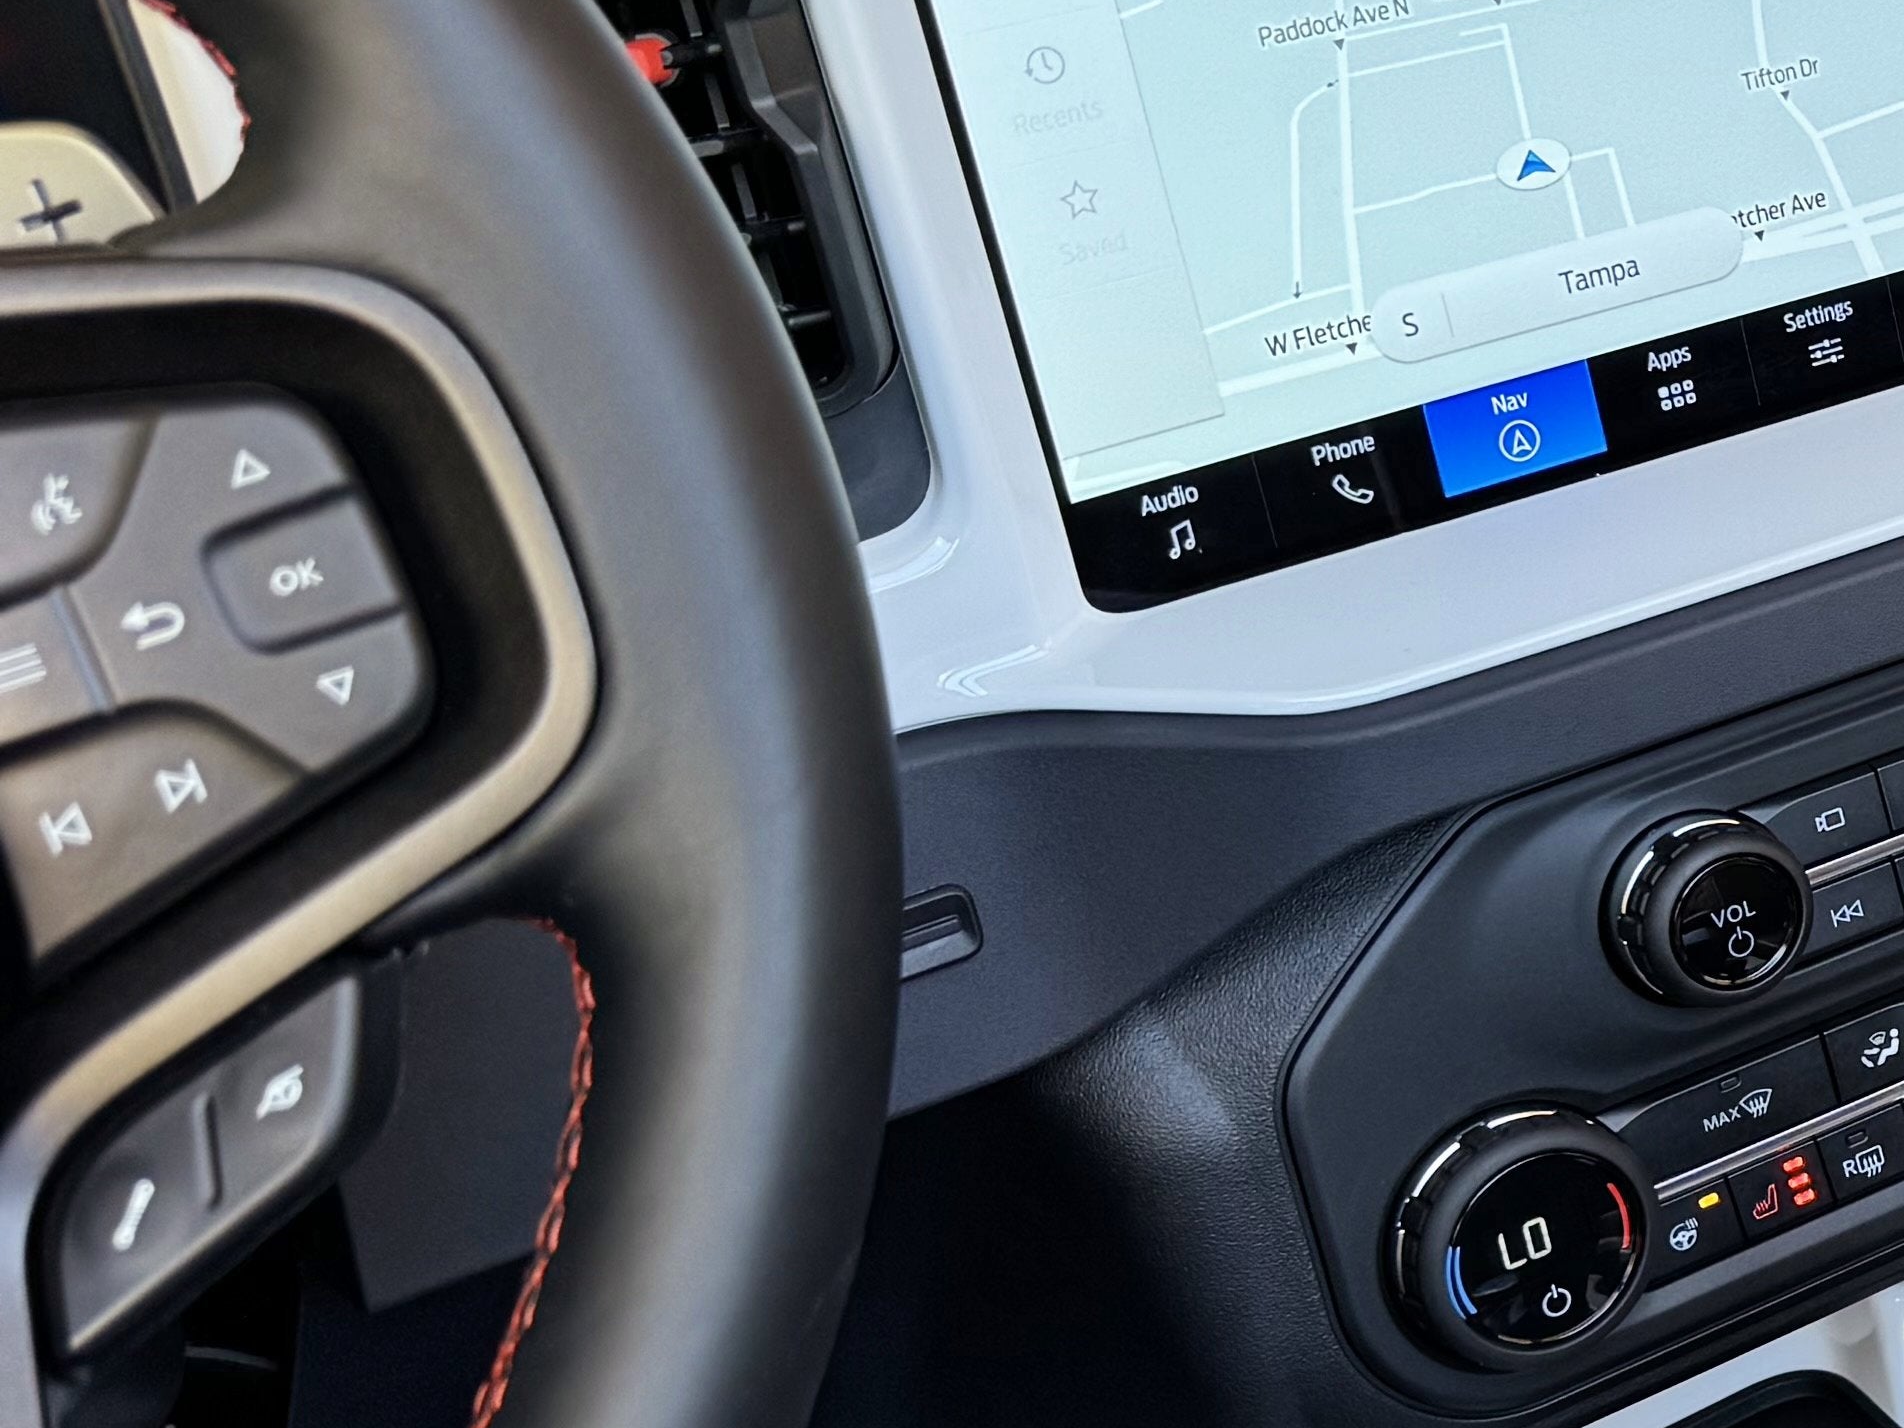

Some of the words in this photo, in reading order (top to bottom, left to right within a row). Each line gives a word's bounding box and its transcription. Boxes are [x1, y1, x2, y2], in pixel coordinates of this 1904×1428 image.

[1257, 10, 1348, 48] Paddock
[1352, 3, 1389, 31] Ave
[1741, 65, 1797, 93] Tifton
[1800, 57, 1820, 80] Dr
[1012, 97, 1104, 137] Recents
[1791, 189, 1827, 213] Ave
[1559, 256, 1641, 297] Tampa
[1401, 312, 1420, 338] S
[1783, 296, 1854, 335] Settings
[1265, 335, 1290, 358] W
[1292, 314, 1372, 350] Fletche
[1647, 342, 1692, 374] Apps
[1491, 388, 1529, 416] Nav
[1311, 432, 1376, 466] Phone
[1140, 482, 1200, 518] Audio
[270, 556, 324, 597] OK
[1710, 898, 1757, 932] VOL
[1702, 1105, 1742, 1134] MAX
